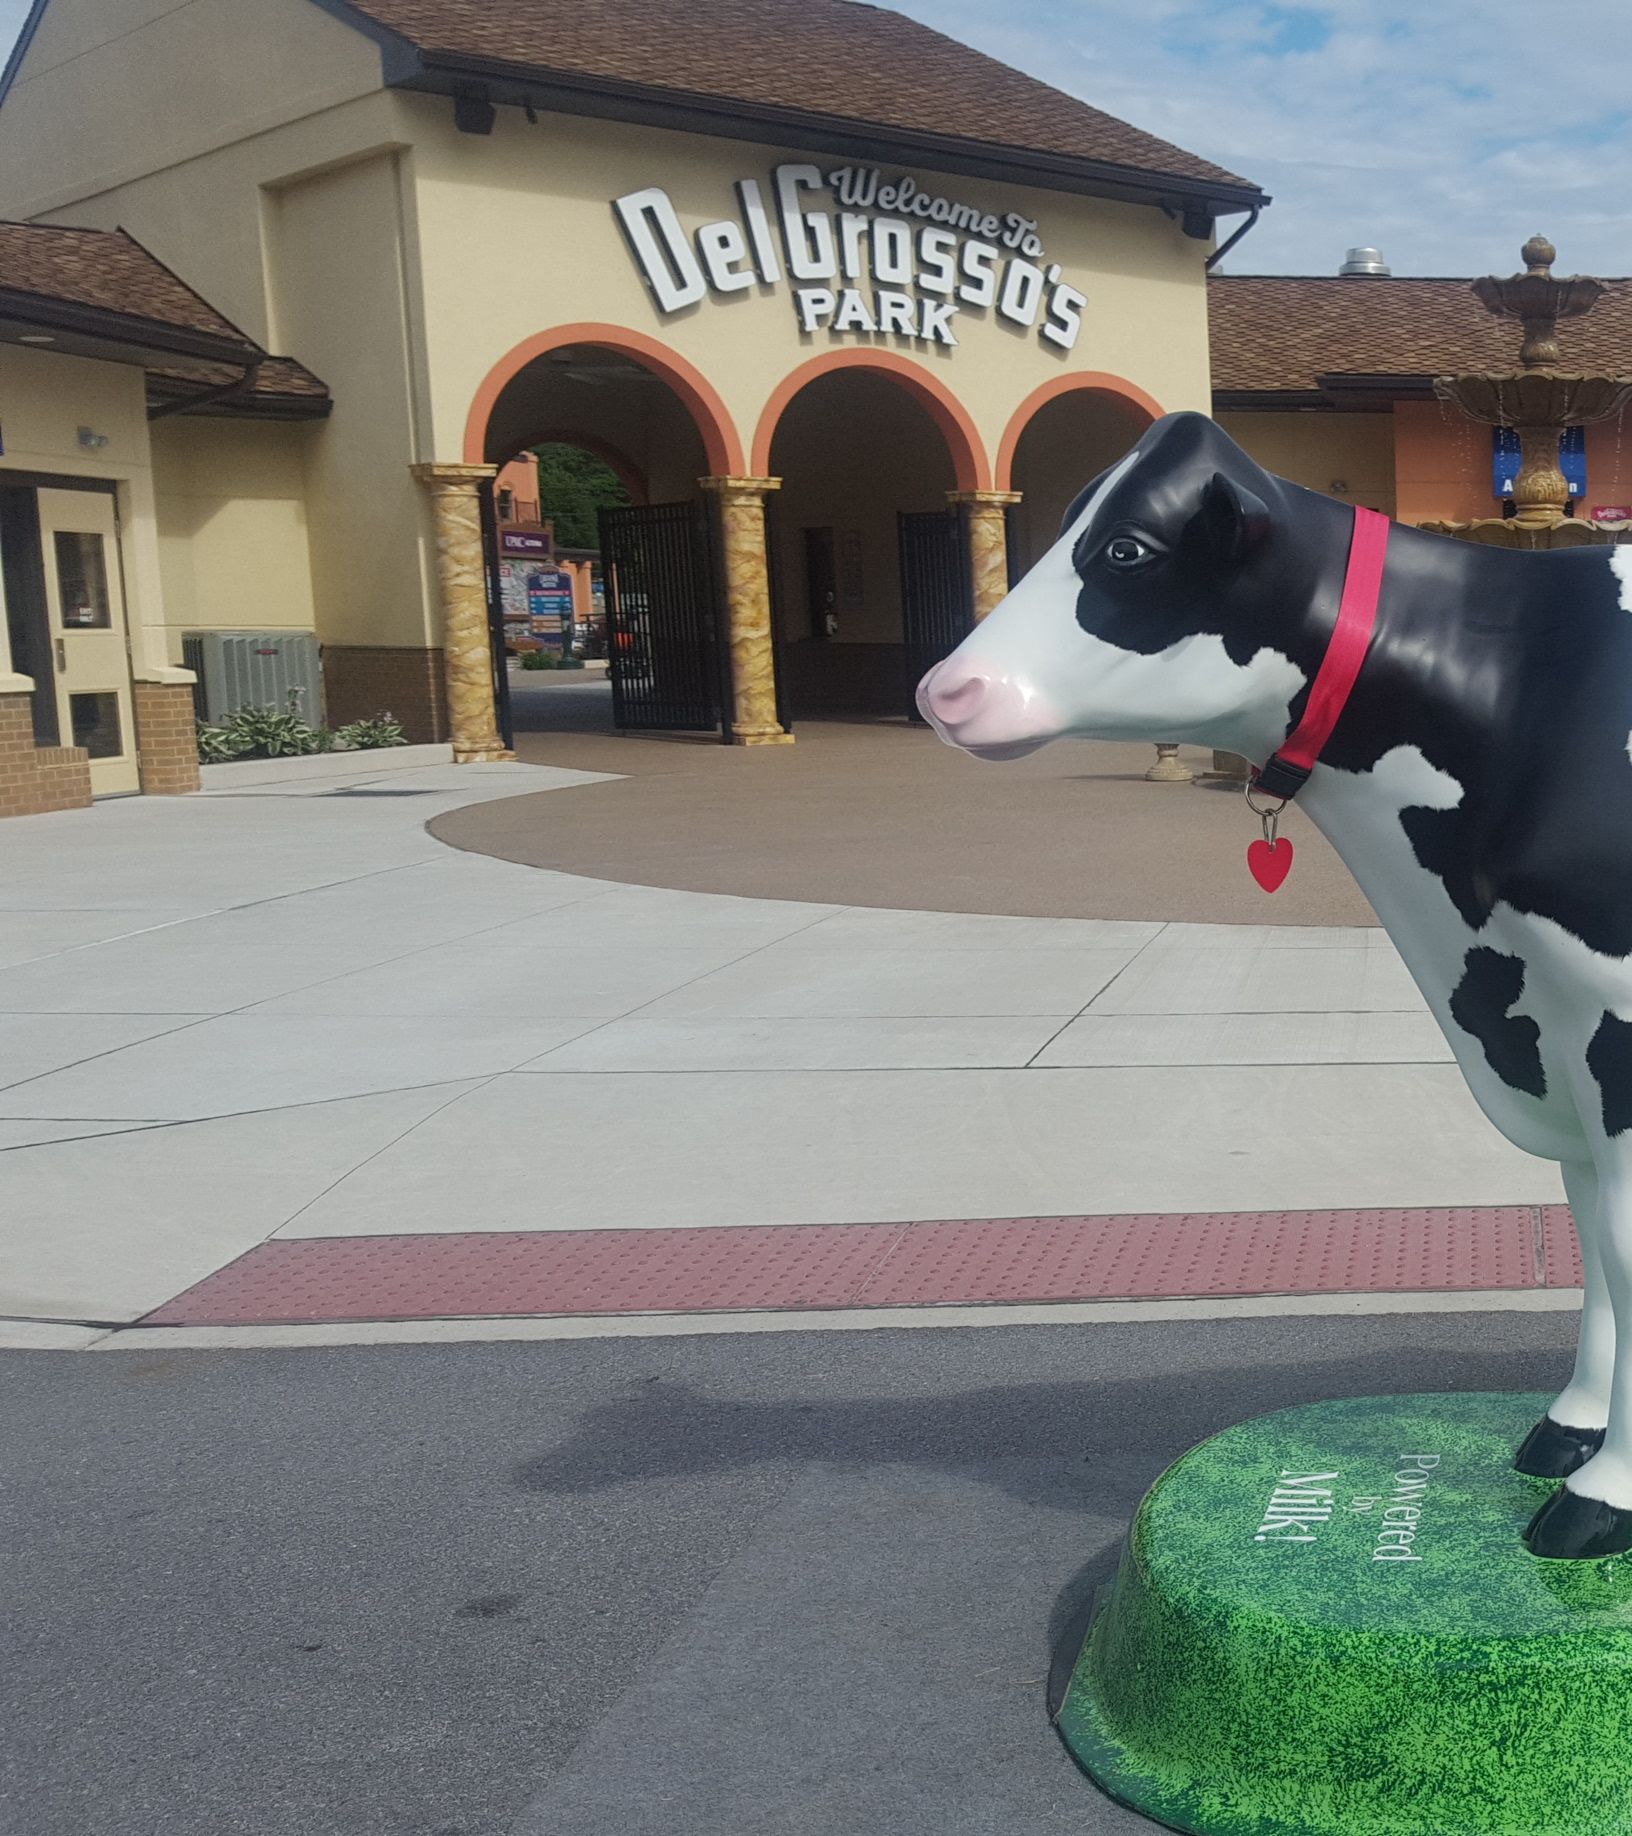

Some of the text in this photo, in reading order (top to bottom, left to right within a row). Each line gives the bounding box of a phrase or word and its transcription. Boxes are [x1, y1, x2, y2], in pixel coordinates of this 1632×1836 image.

[827, 166, 1045, 258] Welcome To
[613, 163, 1088, 350] DelGrosso's
[796, 288, 960, 346] PARK
[1254, 1469, 1339, 1542] Milk!
[1343, 1496, 1382, 1515] by
[1372, 1454, 1441, 1561] Powered
